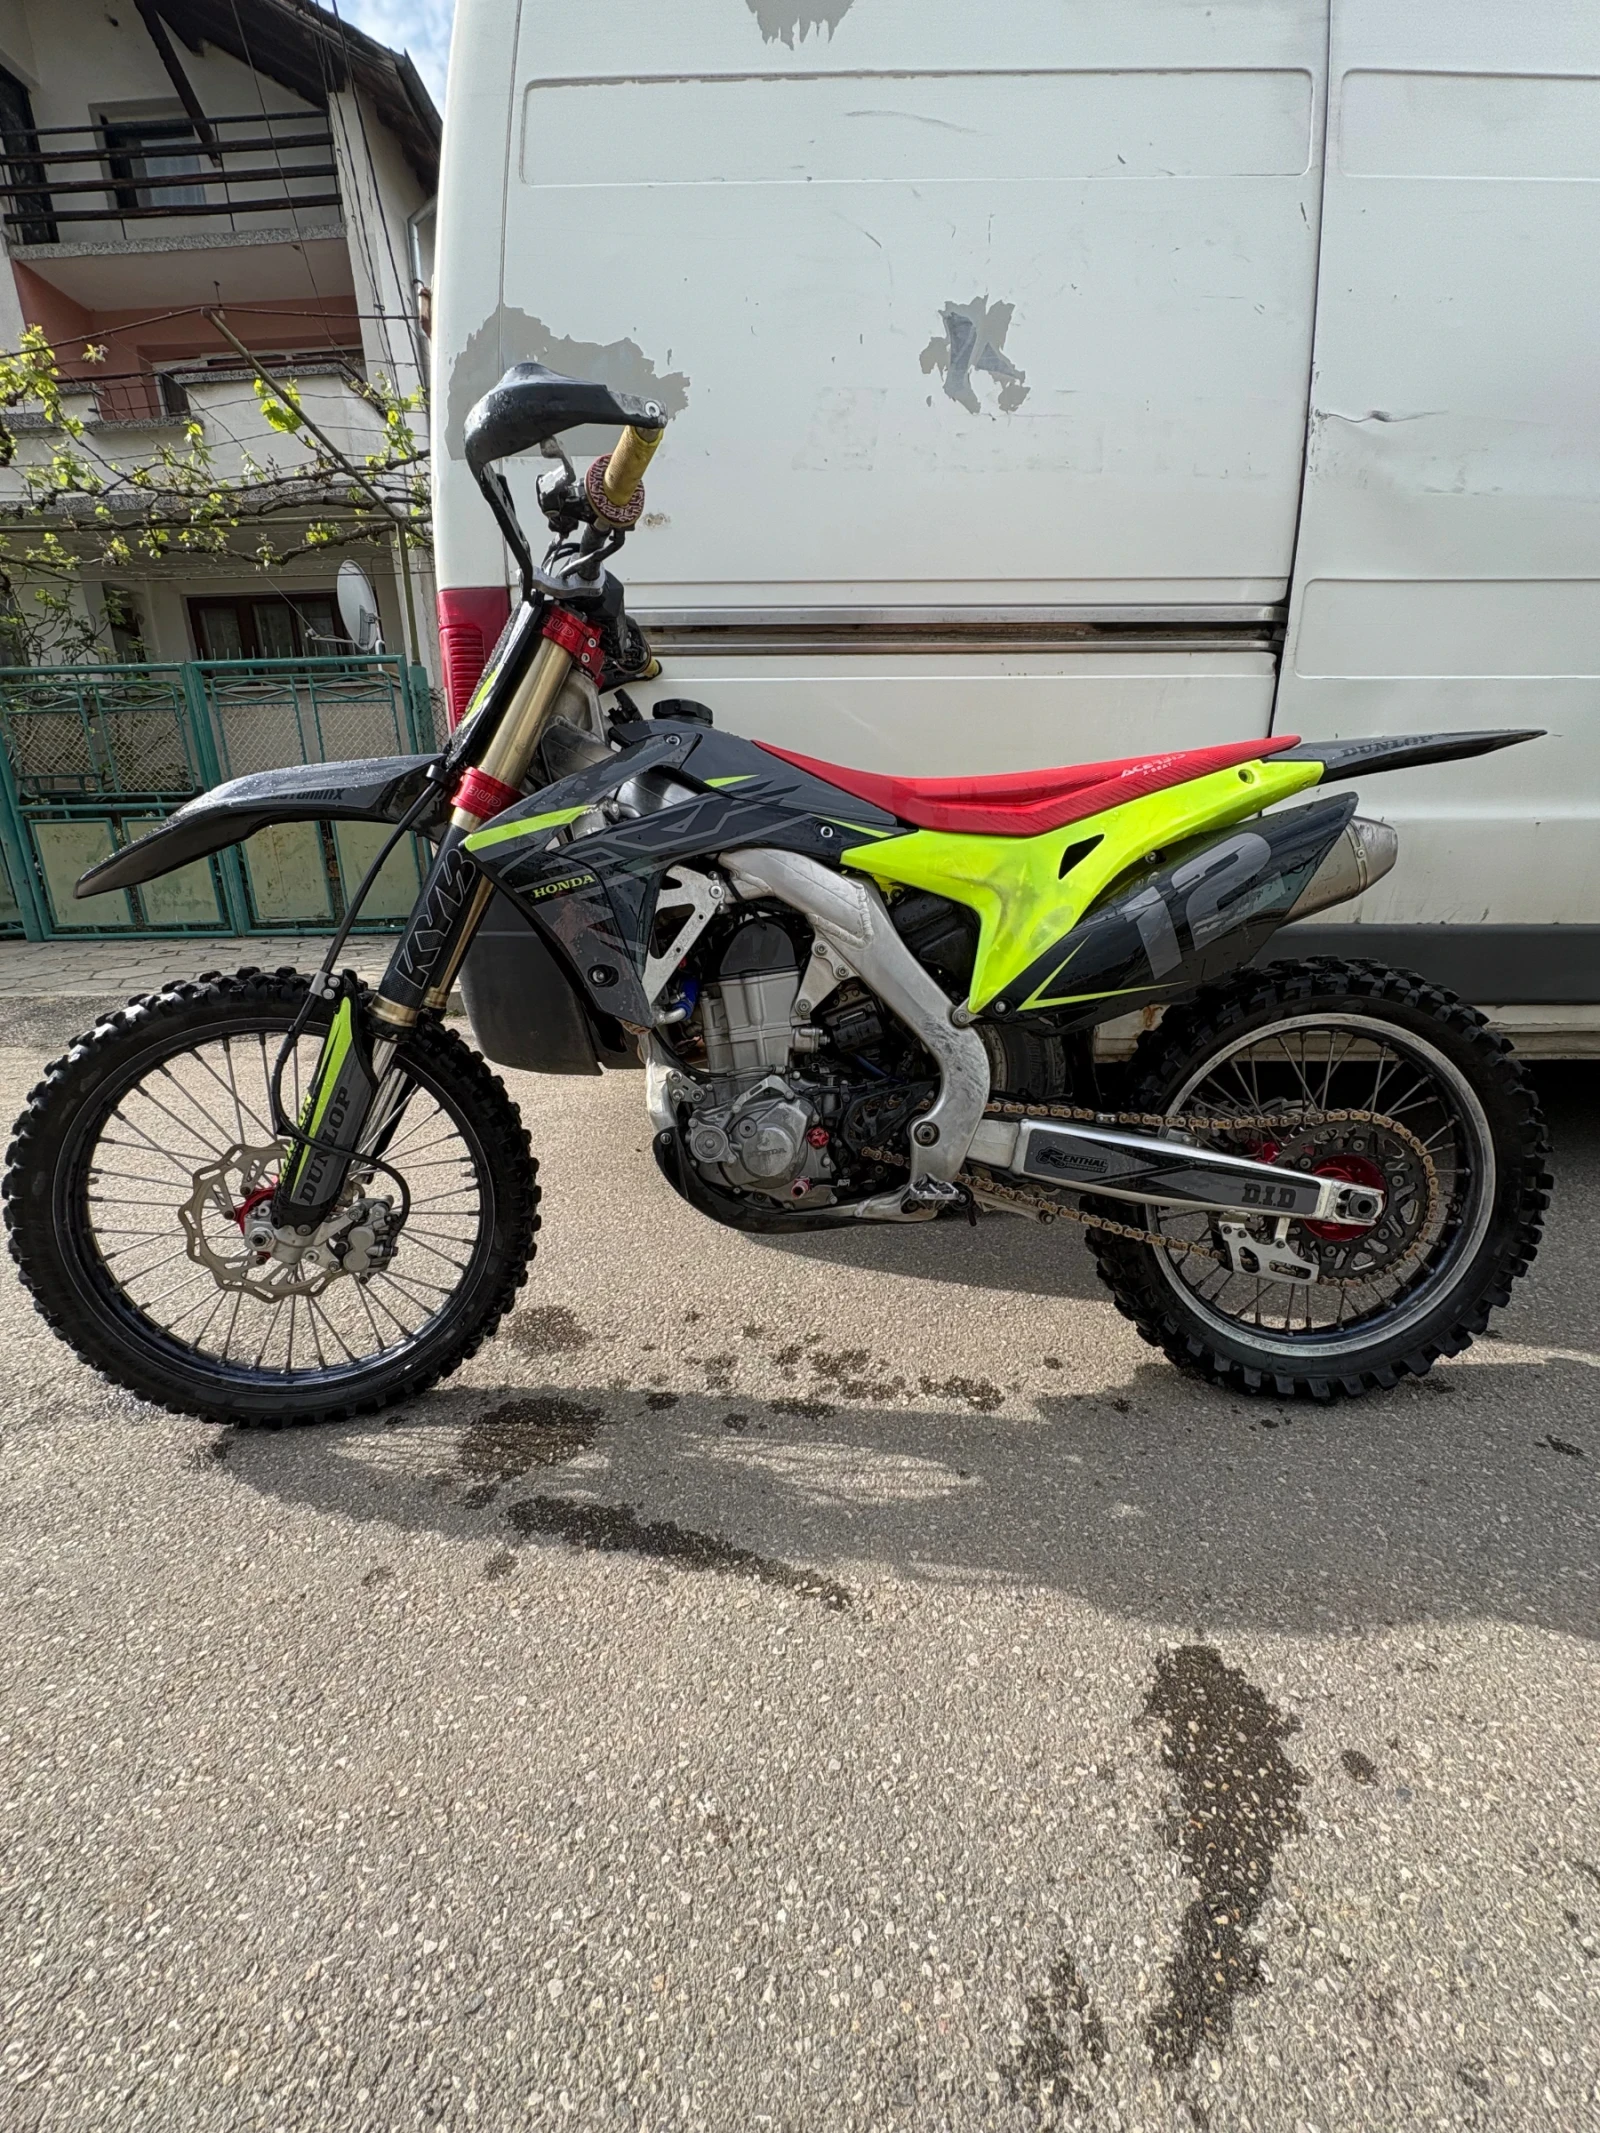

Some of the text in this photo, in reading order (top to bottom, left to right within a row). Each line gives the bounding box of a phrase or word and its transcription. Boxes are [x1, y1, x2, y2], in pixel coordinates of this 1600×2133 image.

[1341, 735, 1433, 757] DUNLOP
[395, 849, 476, 989] KYB
[533, 875, 595, 898] HONDA
[1120, 833, 1286, 980] 12
[300, 1086, 350, 1205] DUNLOP
[1242, 1183, 1297, 1208] D.I.D
